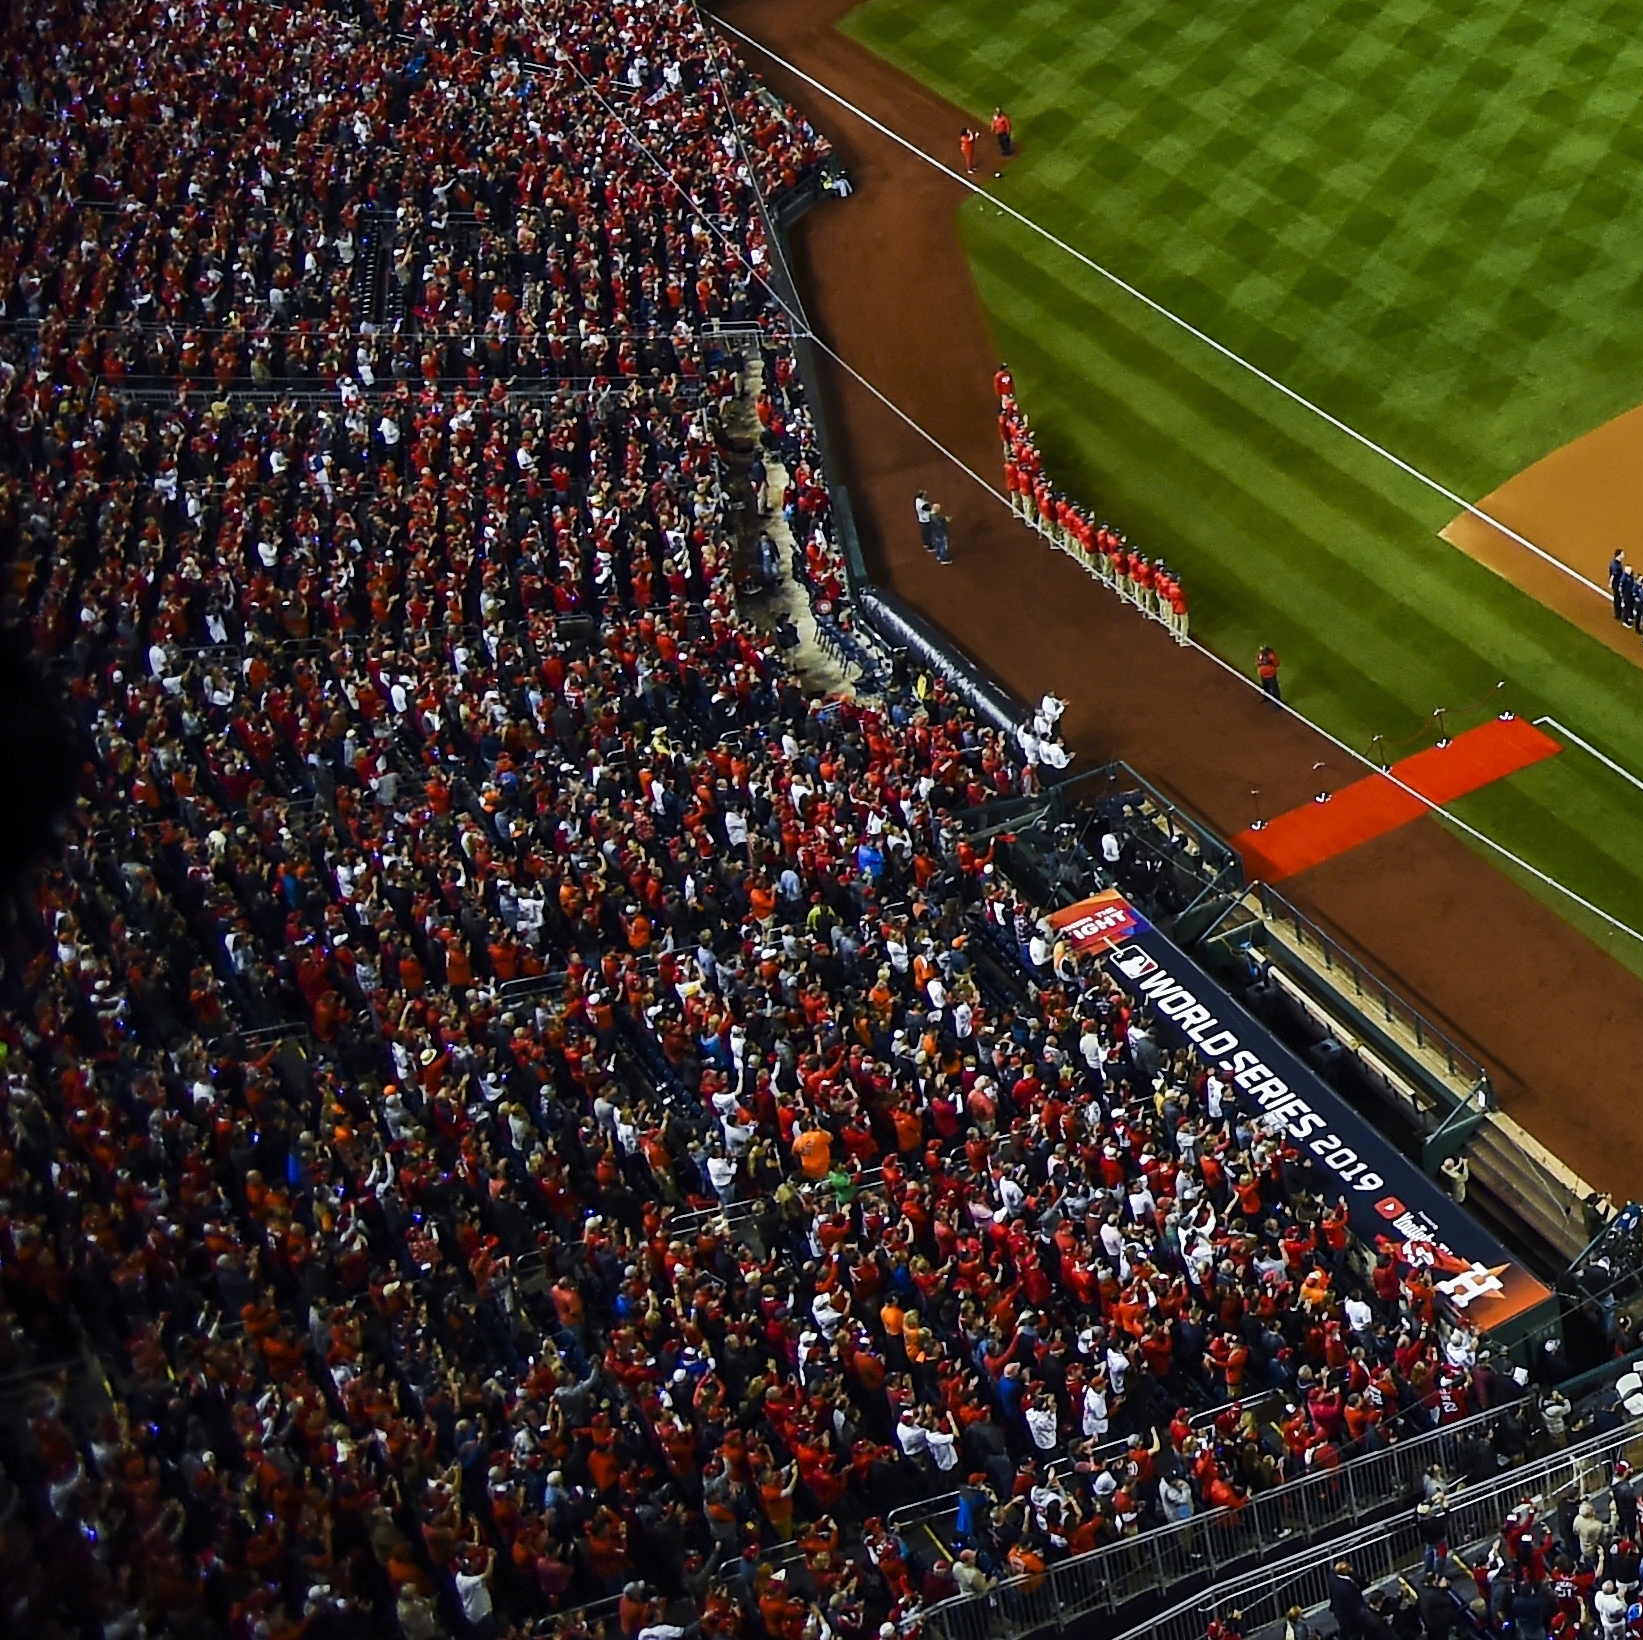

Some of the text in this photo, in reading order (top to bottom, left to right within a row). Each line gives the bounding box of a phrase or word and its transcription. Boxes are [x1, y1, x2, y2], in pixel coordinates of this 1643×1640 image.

[1072, 909, 1127, 940] IGHT
[1140, 970, 1385, 1193] WORLD SERIES 2019
